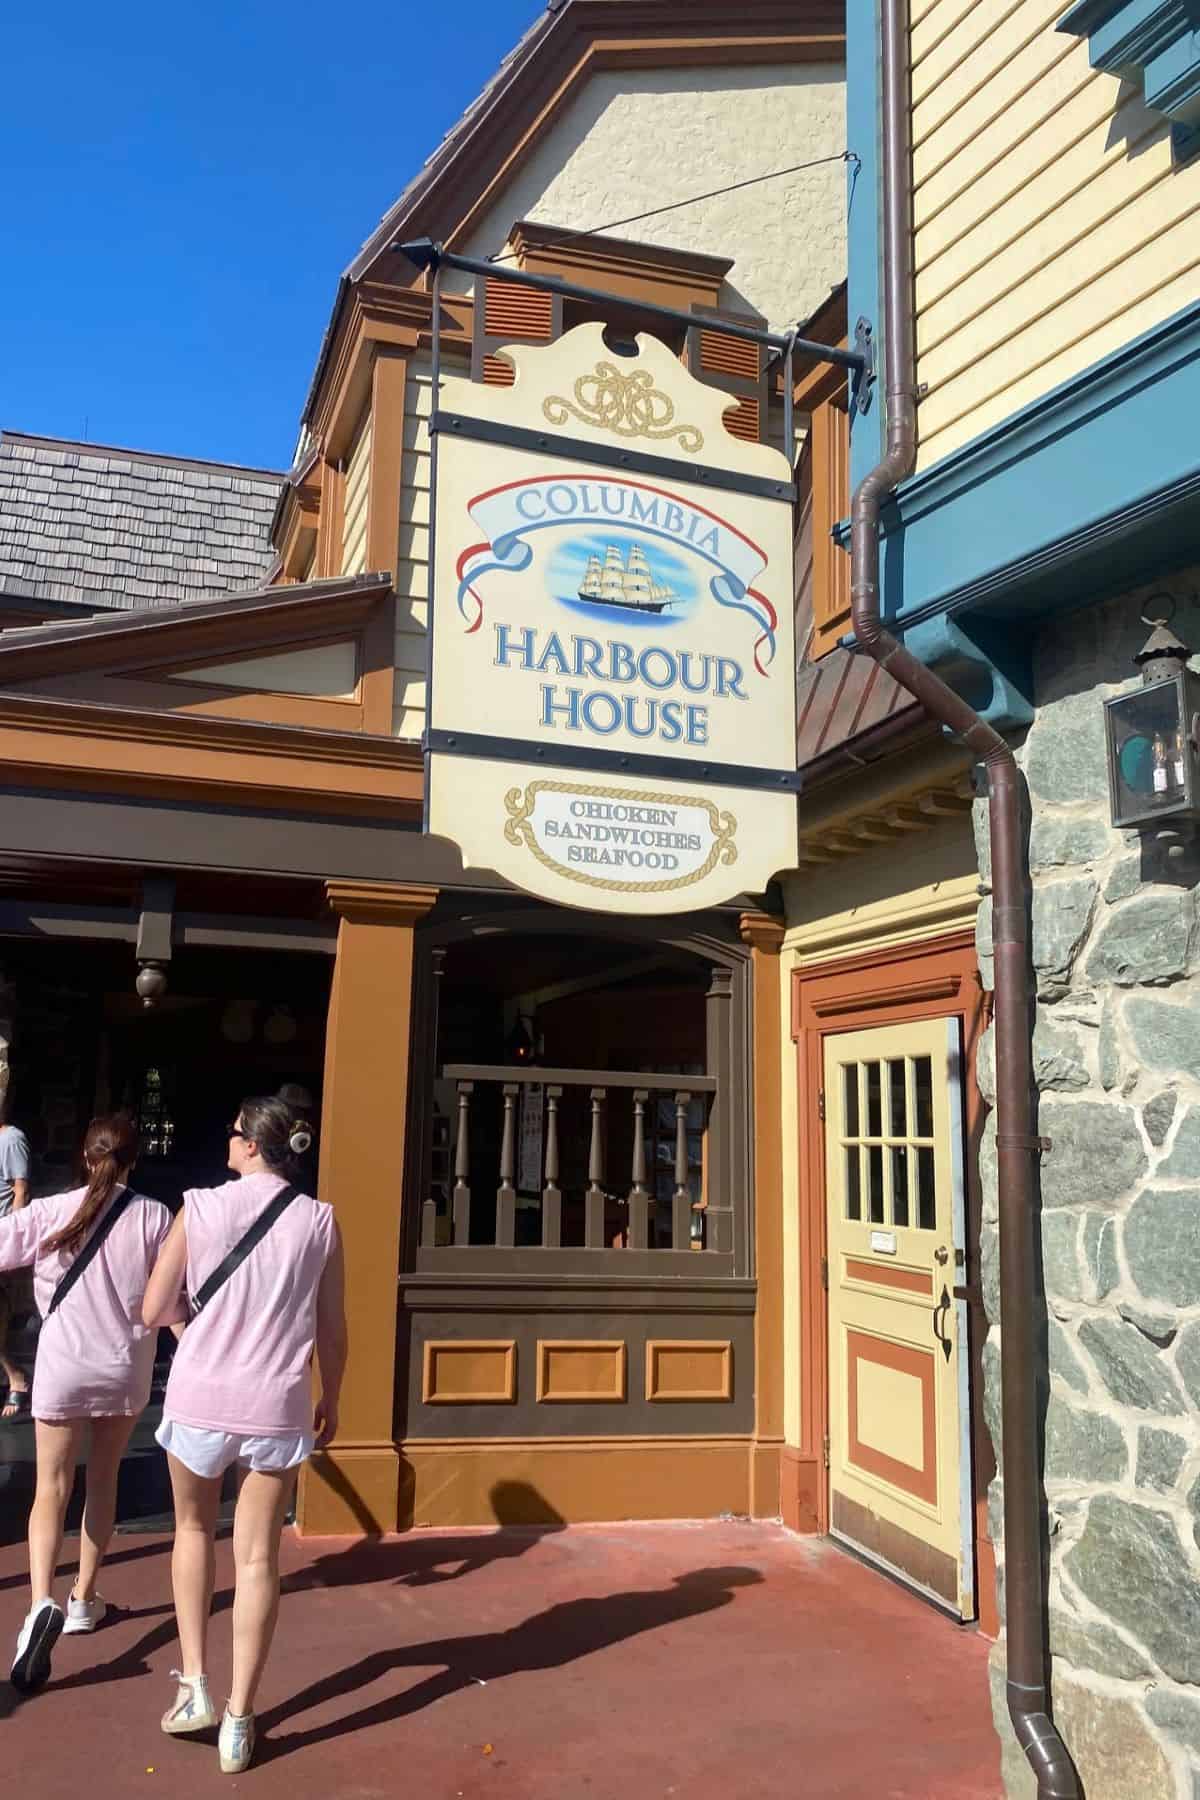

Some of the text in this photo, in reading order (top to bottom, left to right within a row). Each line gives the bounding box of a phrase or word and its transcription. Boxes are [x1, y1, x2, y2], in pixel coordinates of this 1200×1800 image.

[515, 484, 722, 557] COLUMBIA
[493, 623, 749, 700] HARBOUR
[540, 684, 709, 746] HOUSE
[544, 820, 702, 850] SANDWICHES
[570, 801, 678, 827] CHICKEN
[567, 844, 679, 871] SEAFOOD
